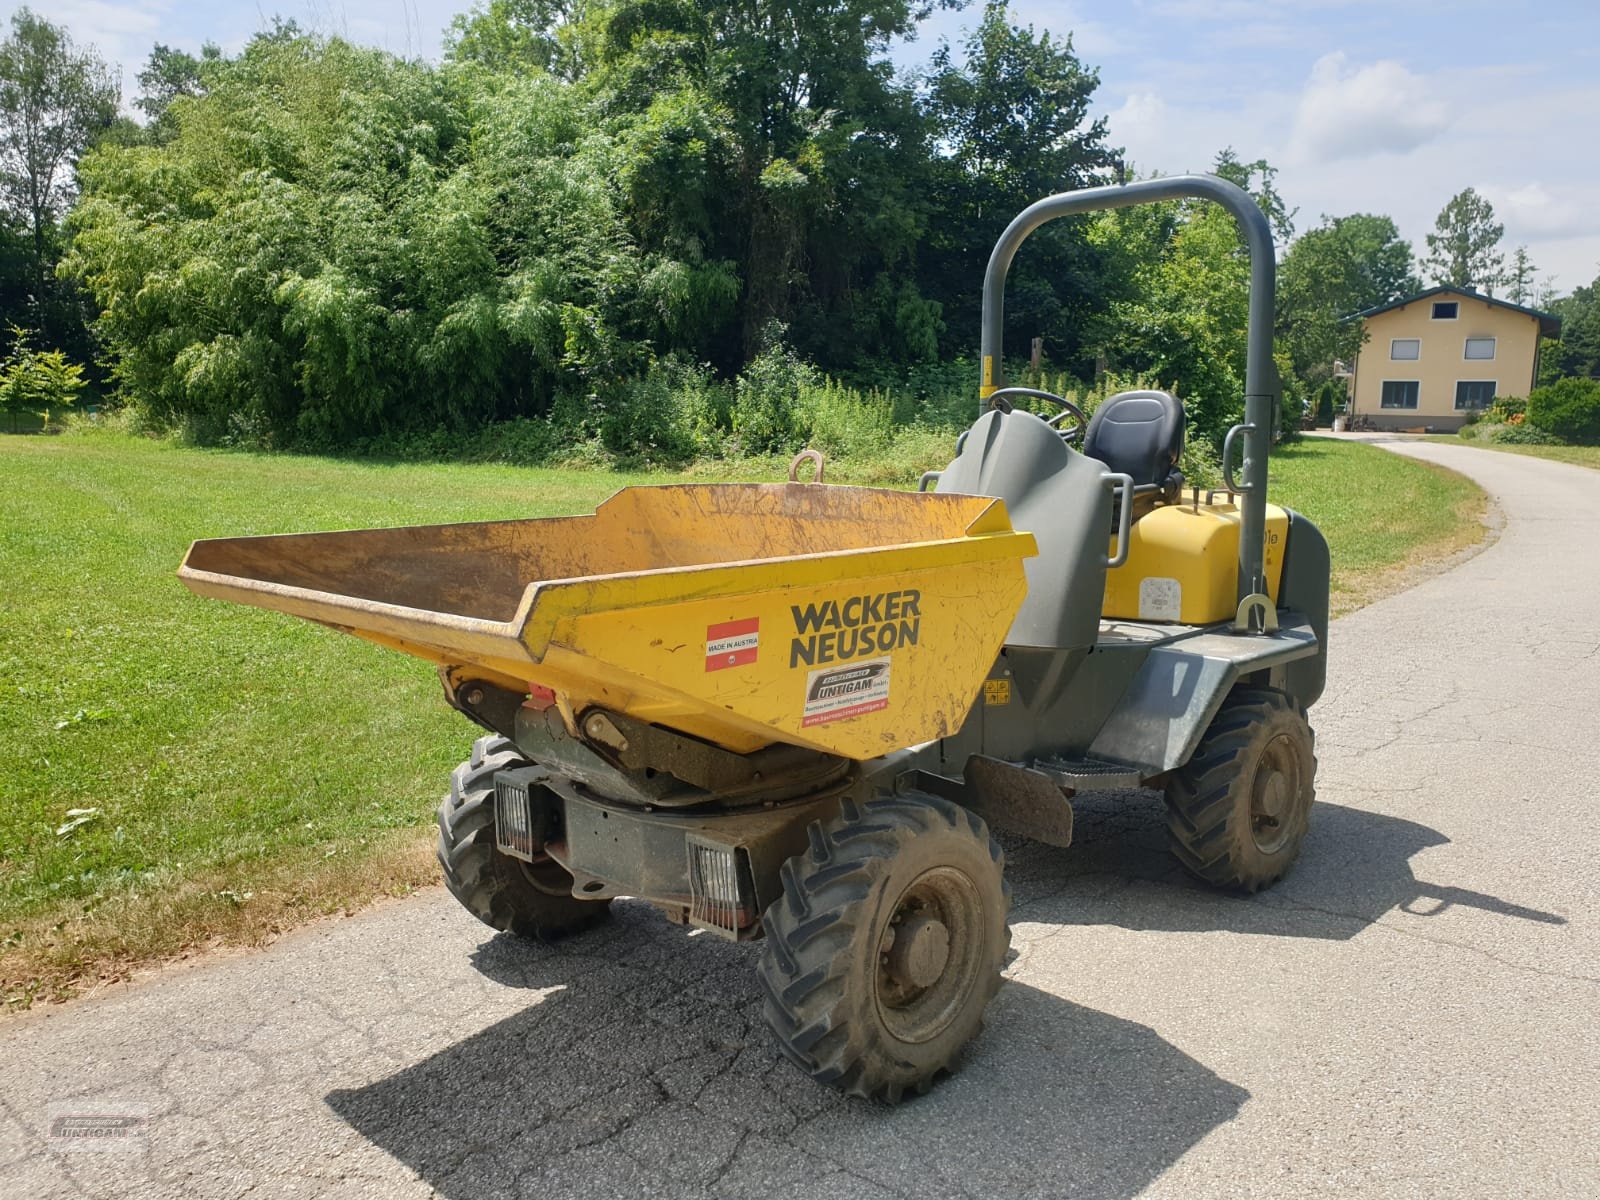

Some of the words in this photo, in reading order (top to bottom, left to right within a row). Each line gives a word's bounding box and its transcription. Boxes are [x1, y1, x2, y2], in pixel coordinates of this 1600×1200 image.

[791, 590, 921, 635] WACKER
[708, 644, 726, 652] MADE
[733, 638, 758, 647] AUSTRIA
[789, 616, 921, 668] NEUSON
